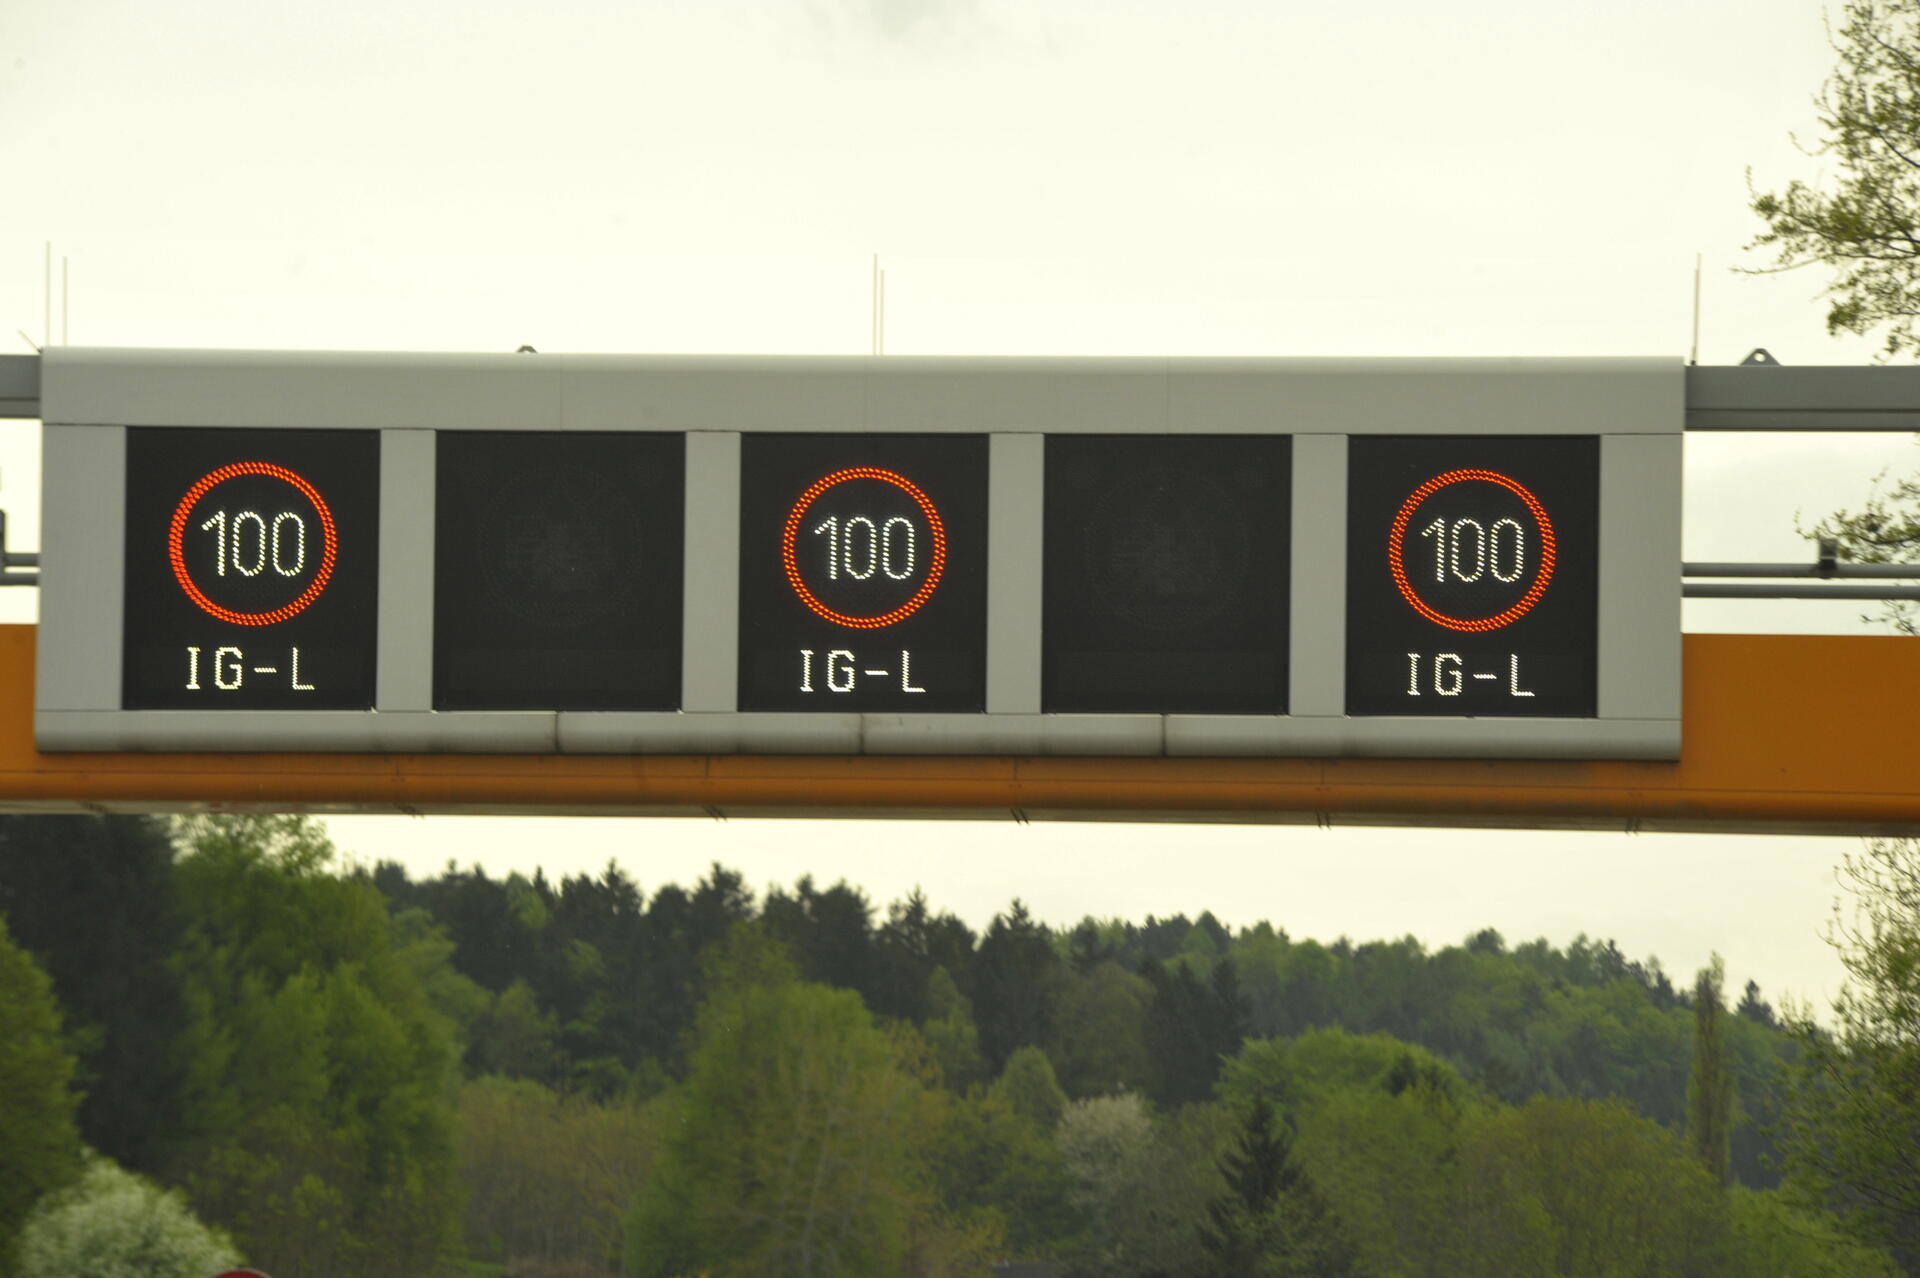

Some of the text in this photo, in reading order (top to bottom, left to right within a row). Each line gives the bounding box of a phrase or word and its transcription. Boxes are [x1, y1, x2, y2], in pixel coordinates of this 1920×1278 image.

[201, 510, 305, 577] 100
[813, 515, 915, 580] 100
[1421, 517, 1525, 583] 100
[185, 646, 315, 691] IG-L
[799, 649, 926, 693] IG-L
[1407, 652, 1536, 697] IG-L
